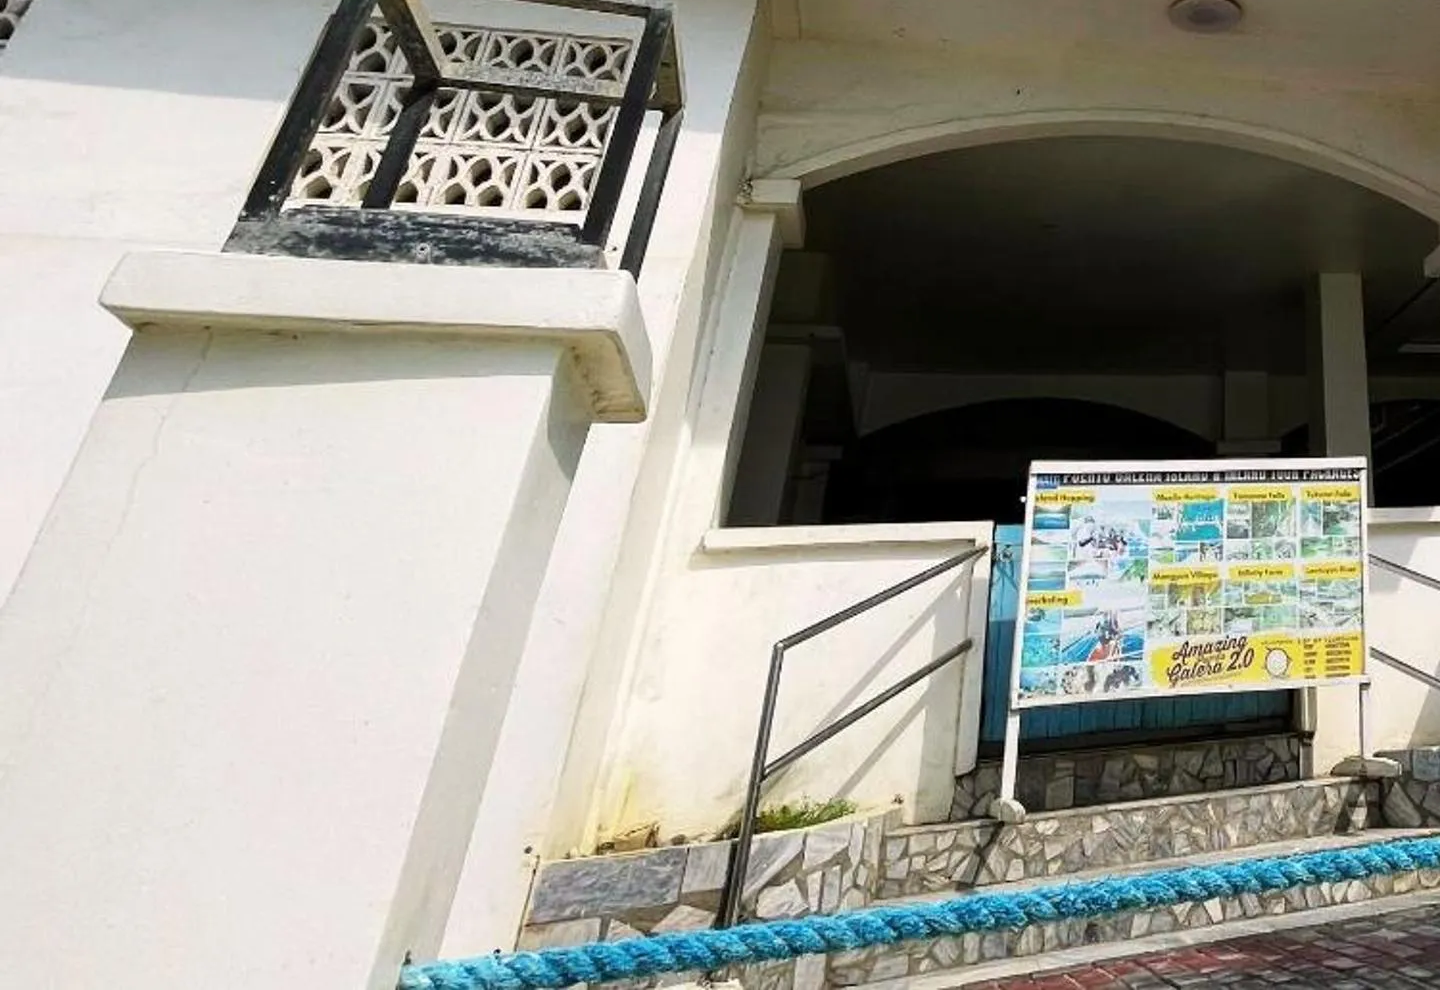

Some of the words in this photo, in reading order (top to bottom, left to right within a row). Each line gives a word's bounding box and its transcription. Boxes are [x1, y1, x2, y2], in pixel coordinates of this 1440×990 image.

[1172, 635, 1249, 665] Amazing
[1166, 662, 1223, 689] Galera
[1227, 649, 1256, 671] 2.0
